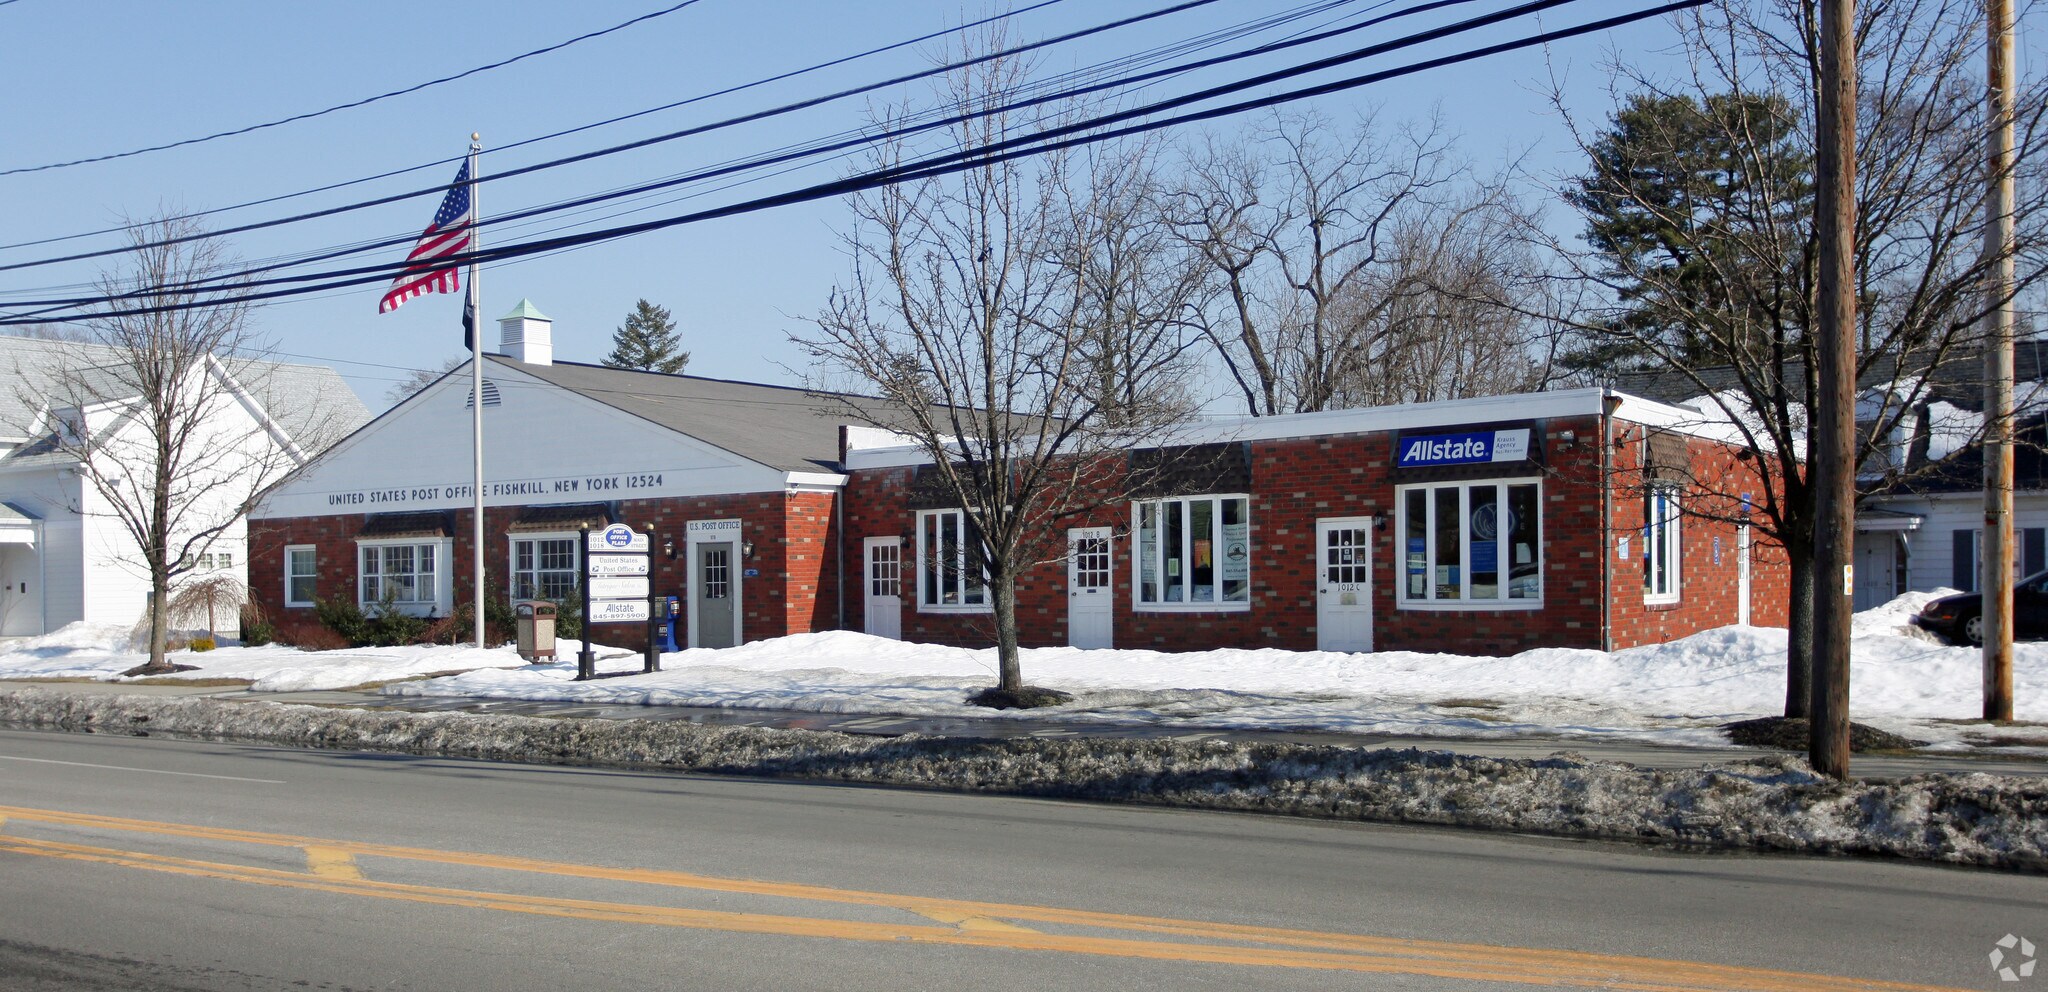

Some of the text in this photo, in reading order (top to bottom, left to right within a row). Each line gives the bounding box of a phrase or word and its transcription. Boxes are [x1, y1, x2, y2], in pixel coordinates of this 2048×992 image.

[1403, 438, 1485, 461] Allstate
[329, 493, 364, 506] UNITED
[370, 489, 406, 503] STATES
[412, 487, 440, 501] POST
[445, 485, 487, 499] OFFIE
[555, 480, 579, 493] NEW
[586, 477, 619, 491] YORK
[626, 474, 663, 488] 12524
[689, 521, 740, 531] U.S. POST OFFICE
[1338, 584, 1354, 592] 1012
[605, 603, 635, 613] Allstate
[592, 612, 646, 620] 845-897-5900
